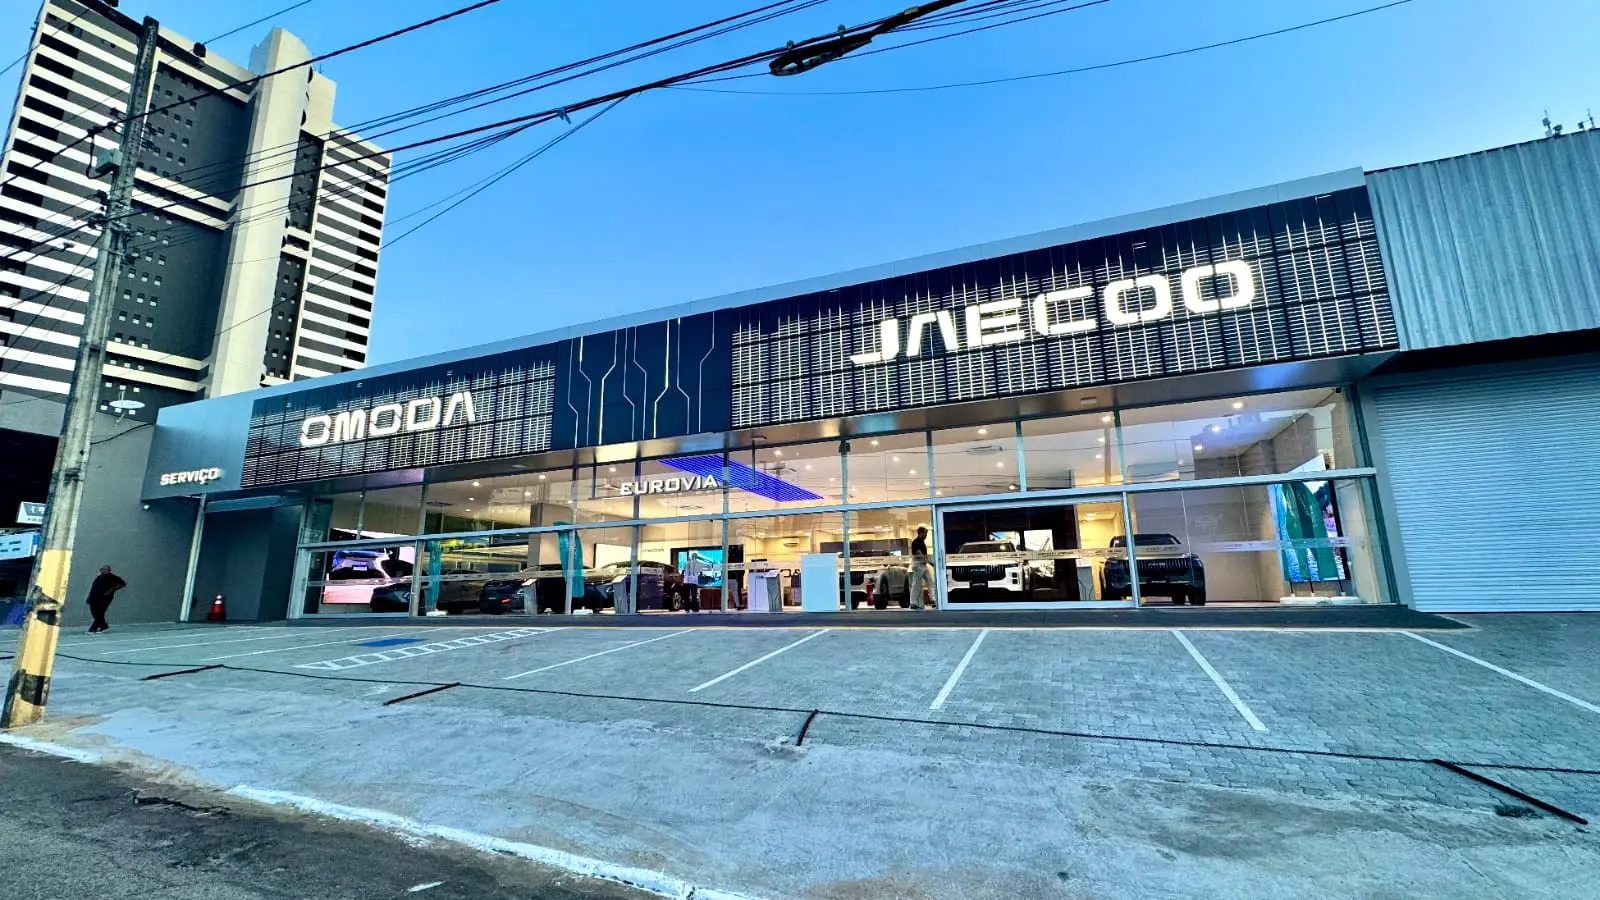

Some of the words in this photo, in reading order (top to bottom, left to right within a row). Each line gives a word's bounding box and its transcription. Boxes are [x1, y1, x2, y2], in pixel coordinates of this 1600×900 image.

[850, 259, 1256, 364] JAECOO
[300, 391, 476, 448] OMODA
[160, 467, 222, 486] SERVIÇO
[620, 474, 719, 496] EUROVIA
